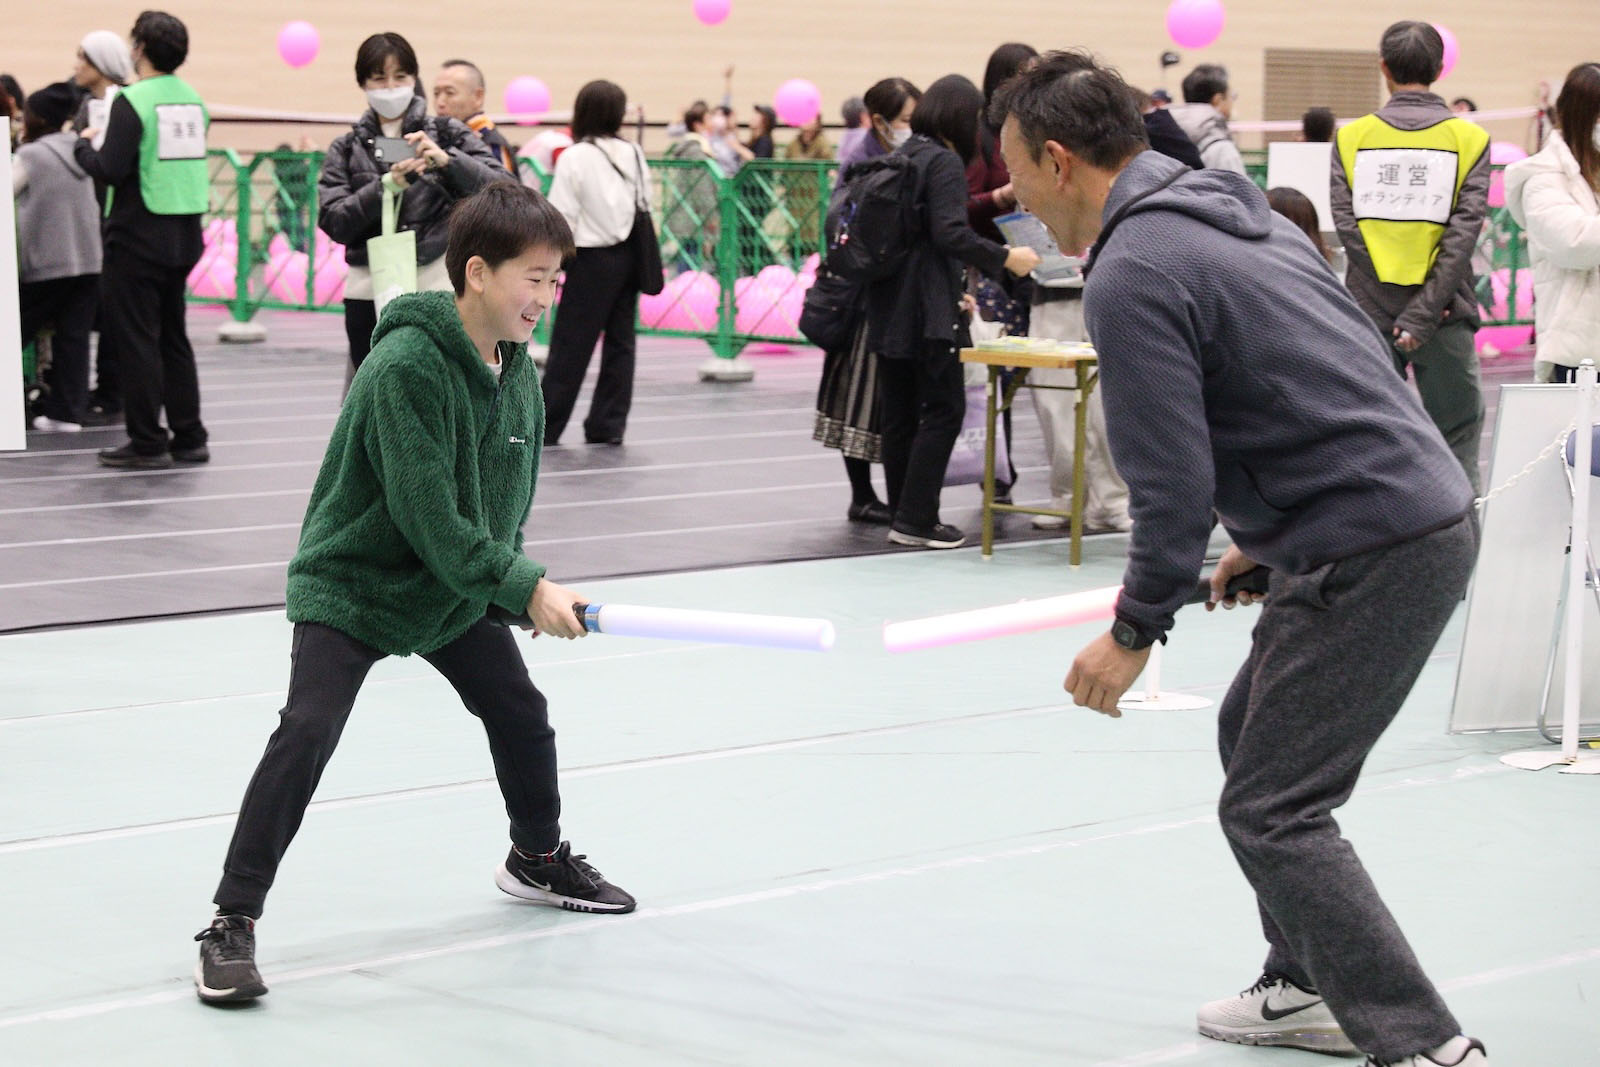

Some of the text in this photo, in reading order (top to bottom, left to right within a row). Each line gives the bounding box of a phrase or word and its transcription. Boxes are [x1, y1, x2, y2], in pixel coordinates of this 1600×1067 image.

[1377, 163, 1428, 187] 運営
[1360, 191, 1443, 206] ボランティア
